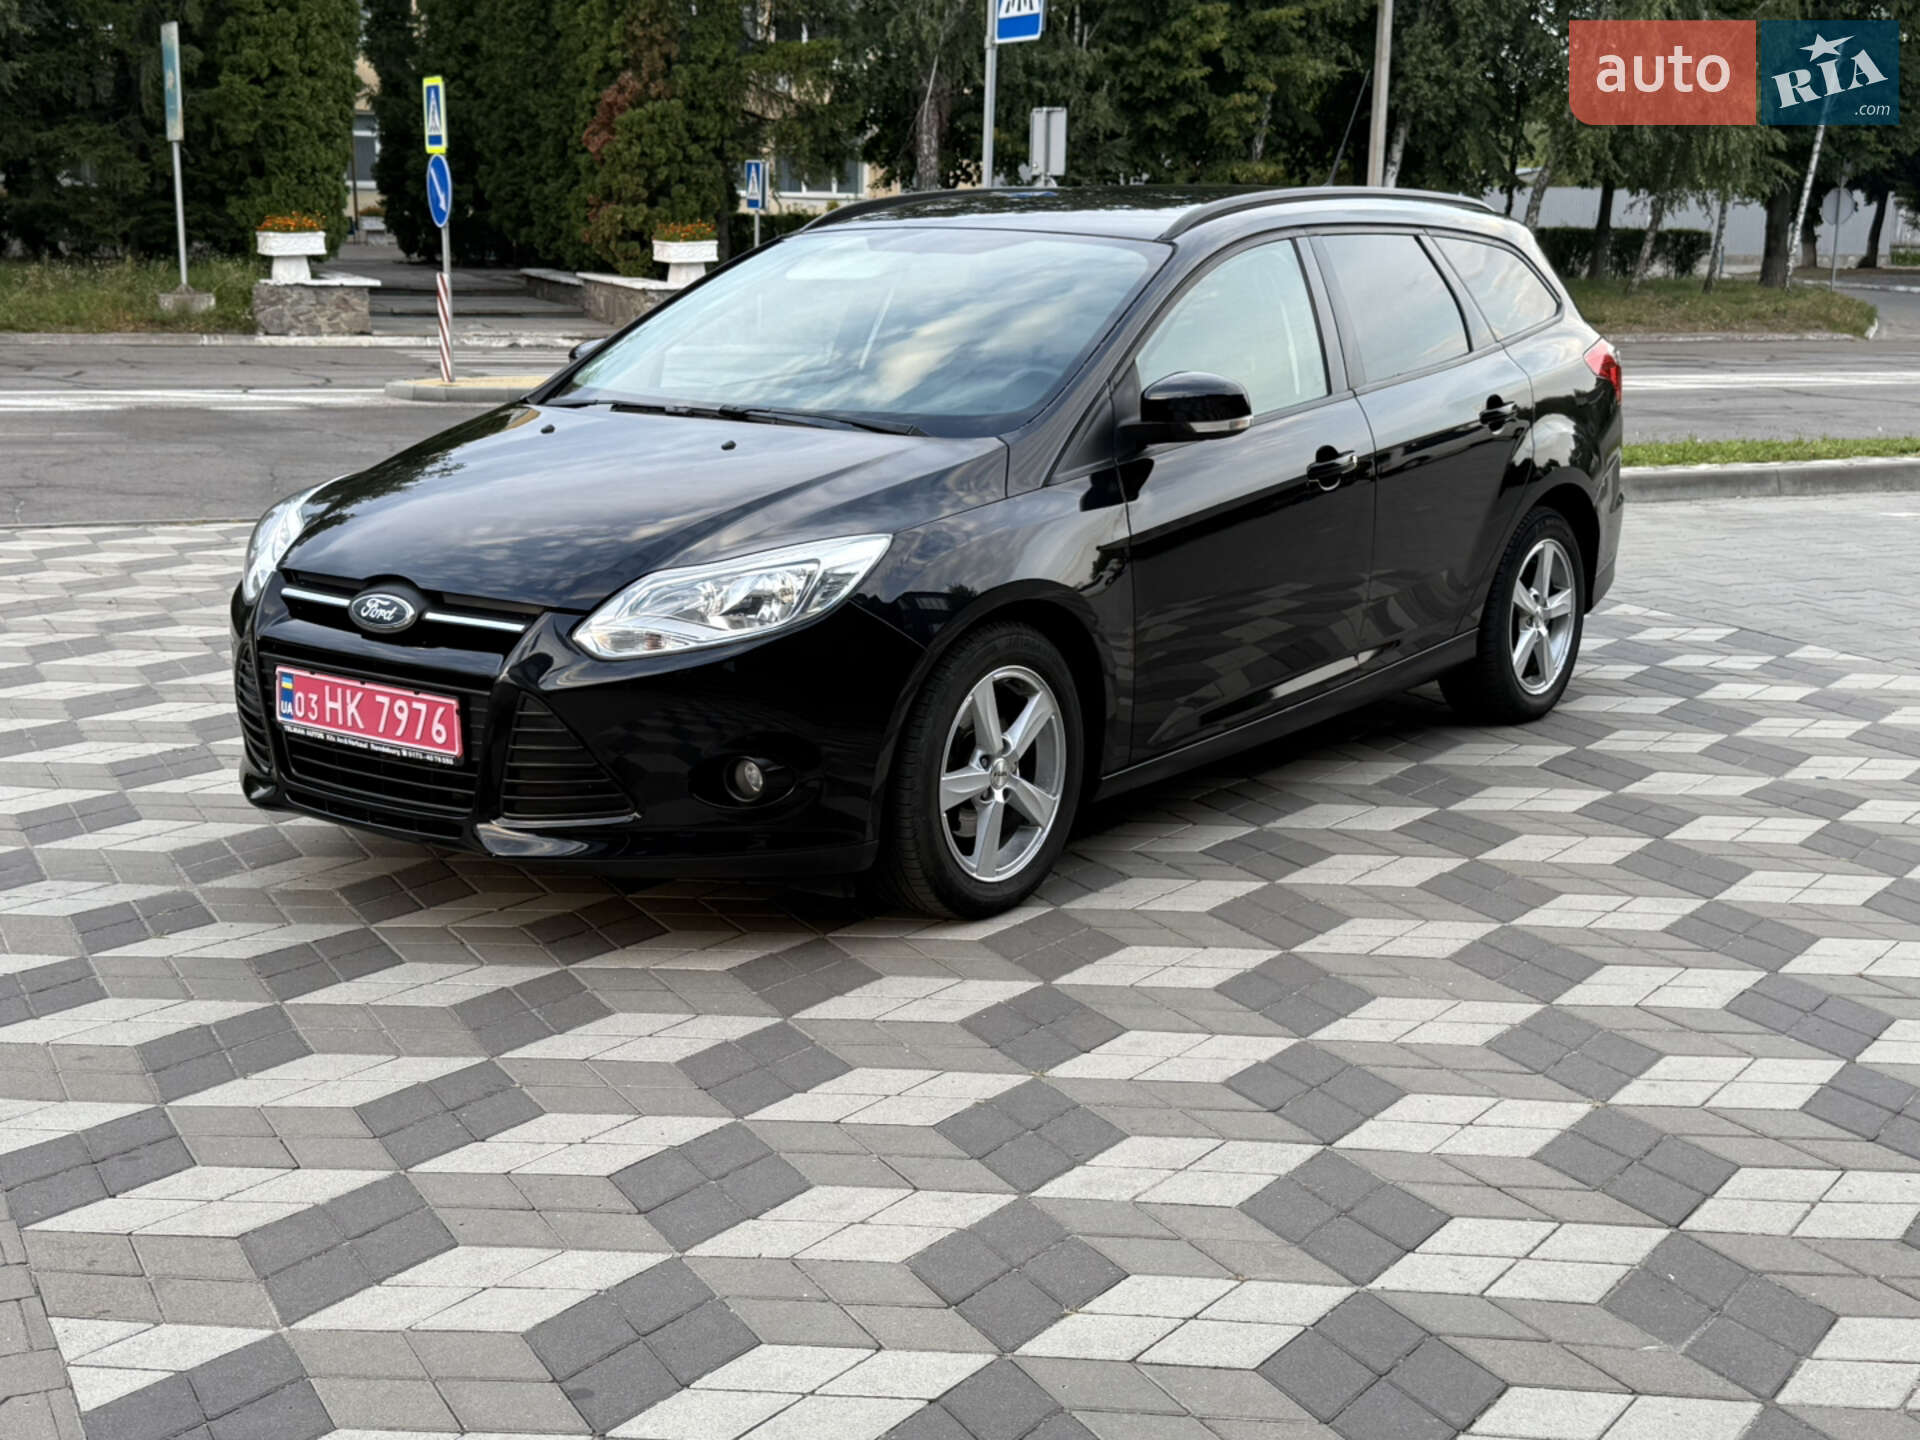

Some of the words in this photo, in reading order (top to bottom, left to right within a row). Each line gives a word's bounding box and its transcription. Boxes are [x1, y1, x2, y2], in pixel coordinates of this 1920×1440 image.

[361, 598, 397, 621] Ford
[281, 700, 293, 716] UA
[295, 691, 319, 721] 03
[325, 685, 365, 729] HK
[375, 695, 448, 745] 7976
